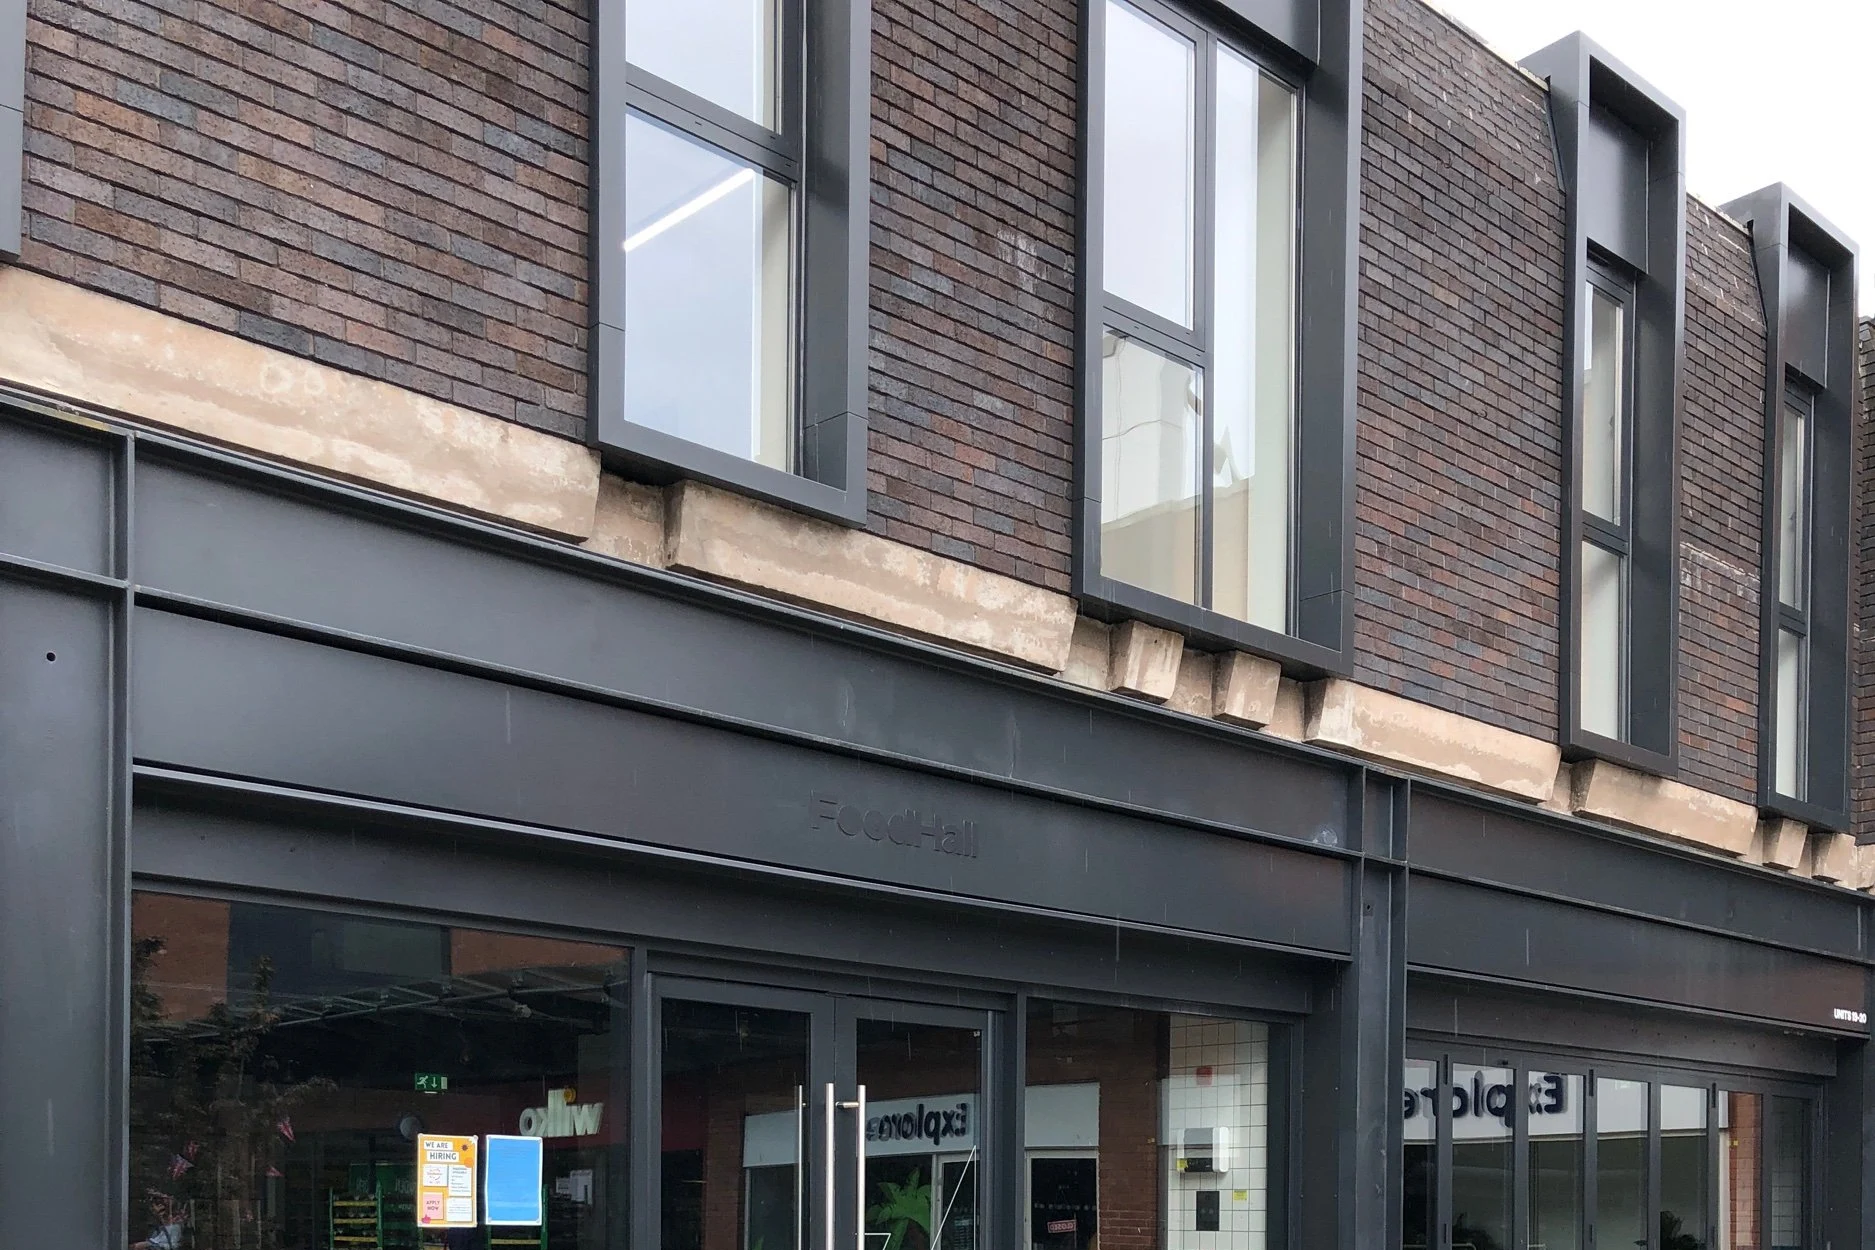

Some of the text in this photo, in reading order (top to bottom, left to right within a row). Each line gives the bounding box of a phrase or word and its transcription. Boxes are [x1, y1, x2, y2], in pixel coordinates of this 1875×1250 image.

[1834, 1008, 1851, 1021] UNITS
[425, 1141, 435, 1149] WE
[429, 1151, 457, 1161] HIRING
